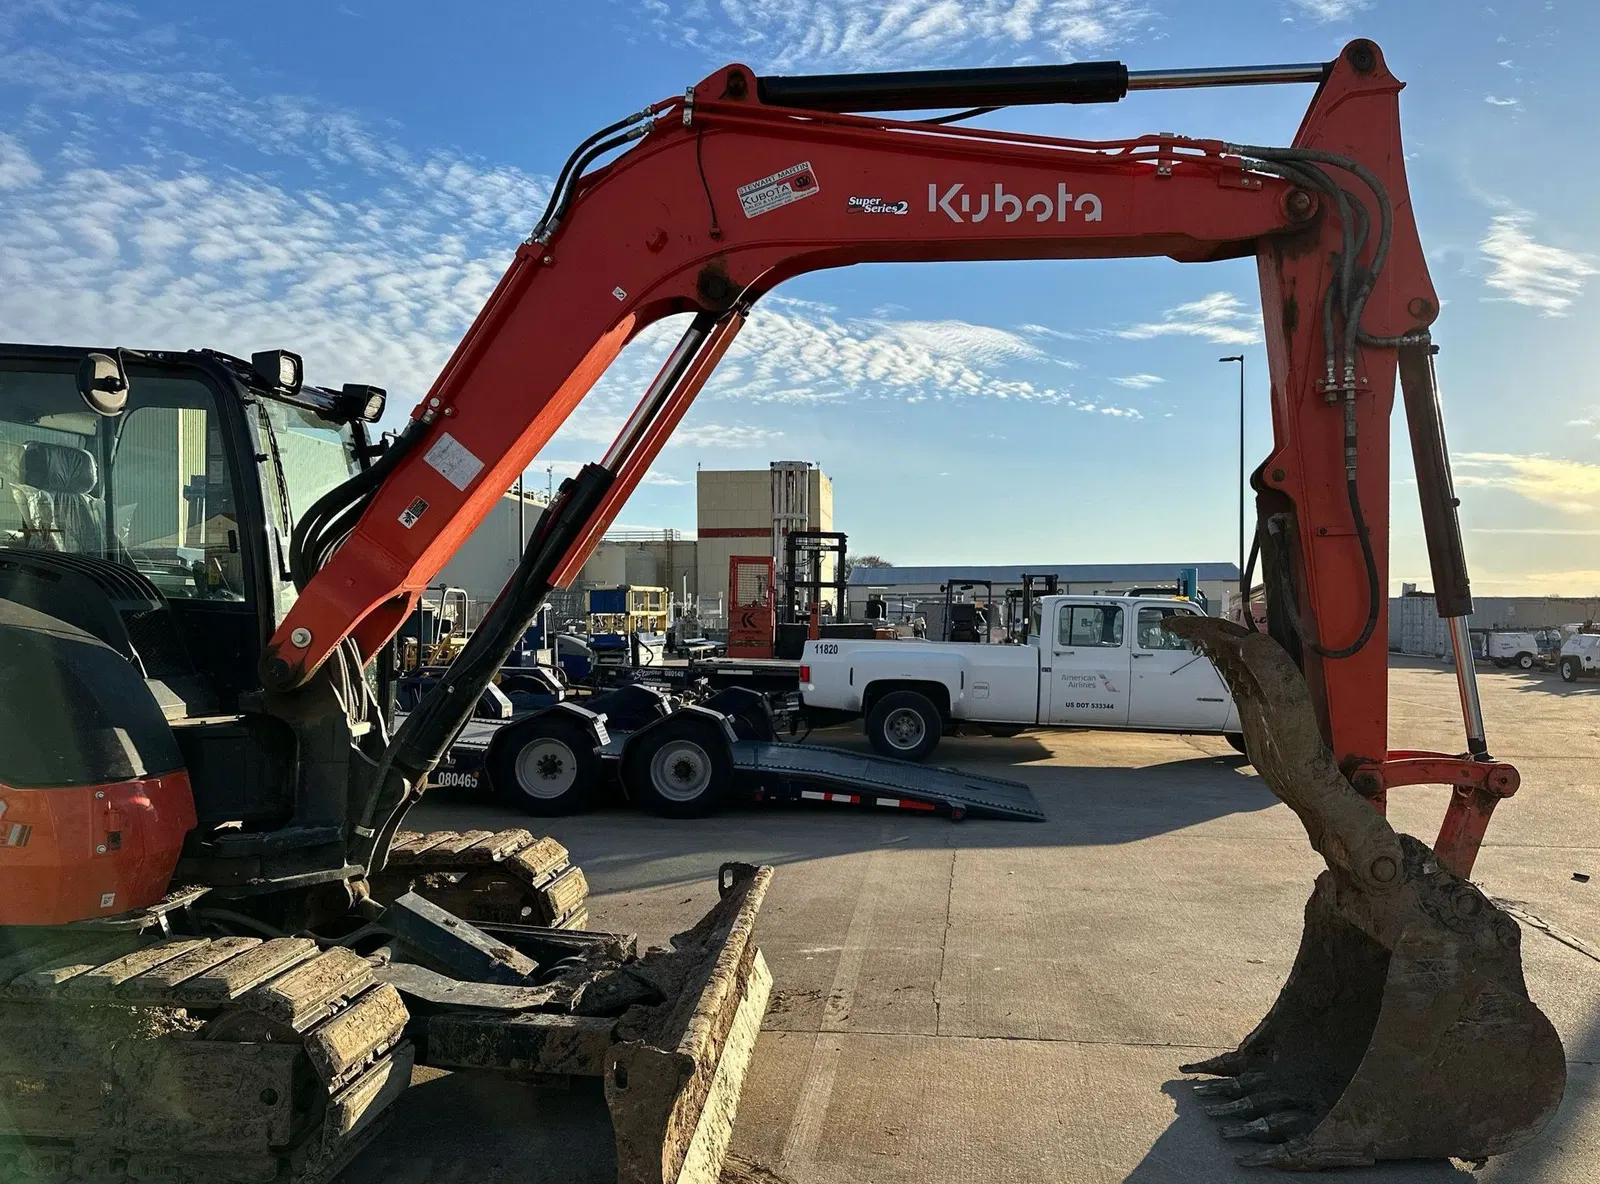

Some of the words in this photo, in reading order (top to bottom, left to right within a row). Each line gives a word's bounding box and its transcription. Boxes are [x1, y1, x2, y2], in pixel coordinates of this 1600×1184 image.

[738, 176, 776, 194] STEWART
[778, 163, 809, 179] MARTIN
[741, 185, 790, 207] KUBOTA
[848, 196, 882, 207] Super
[928, 182, 1103, 223] Kubota
[814, 643, 839, 655] 11820
[1061, 674, 1097, 682] American
[1067, 681, 1097, 689] Airlines
[438, 771, 478, 788] 080465
